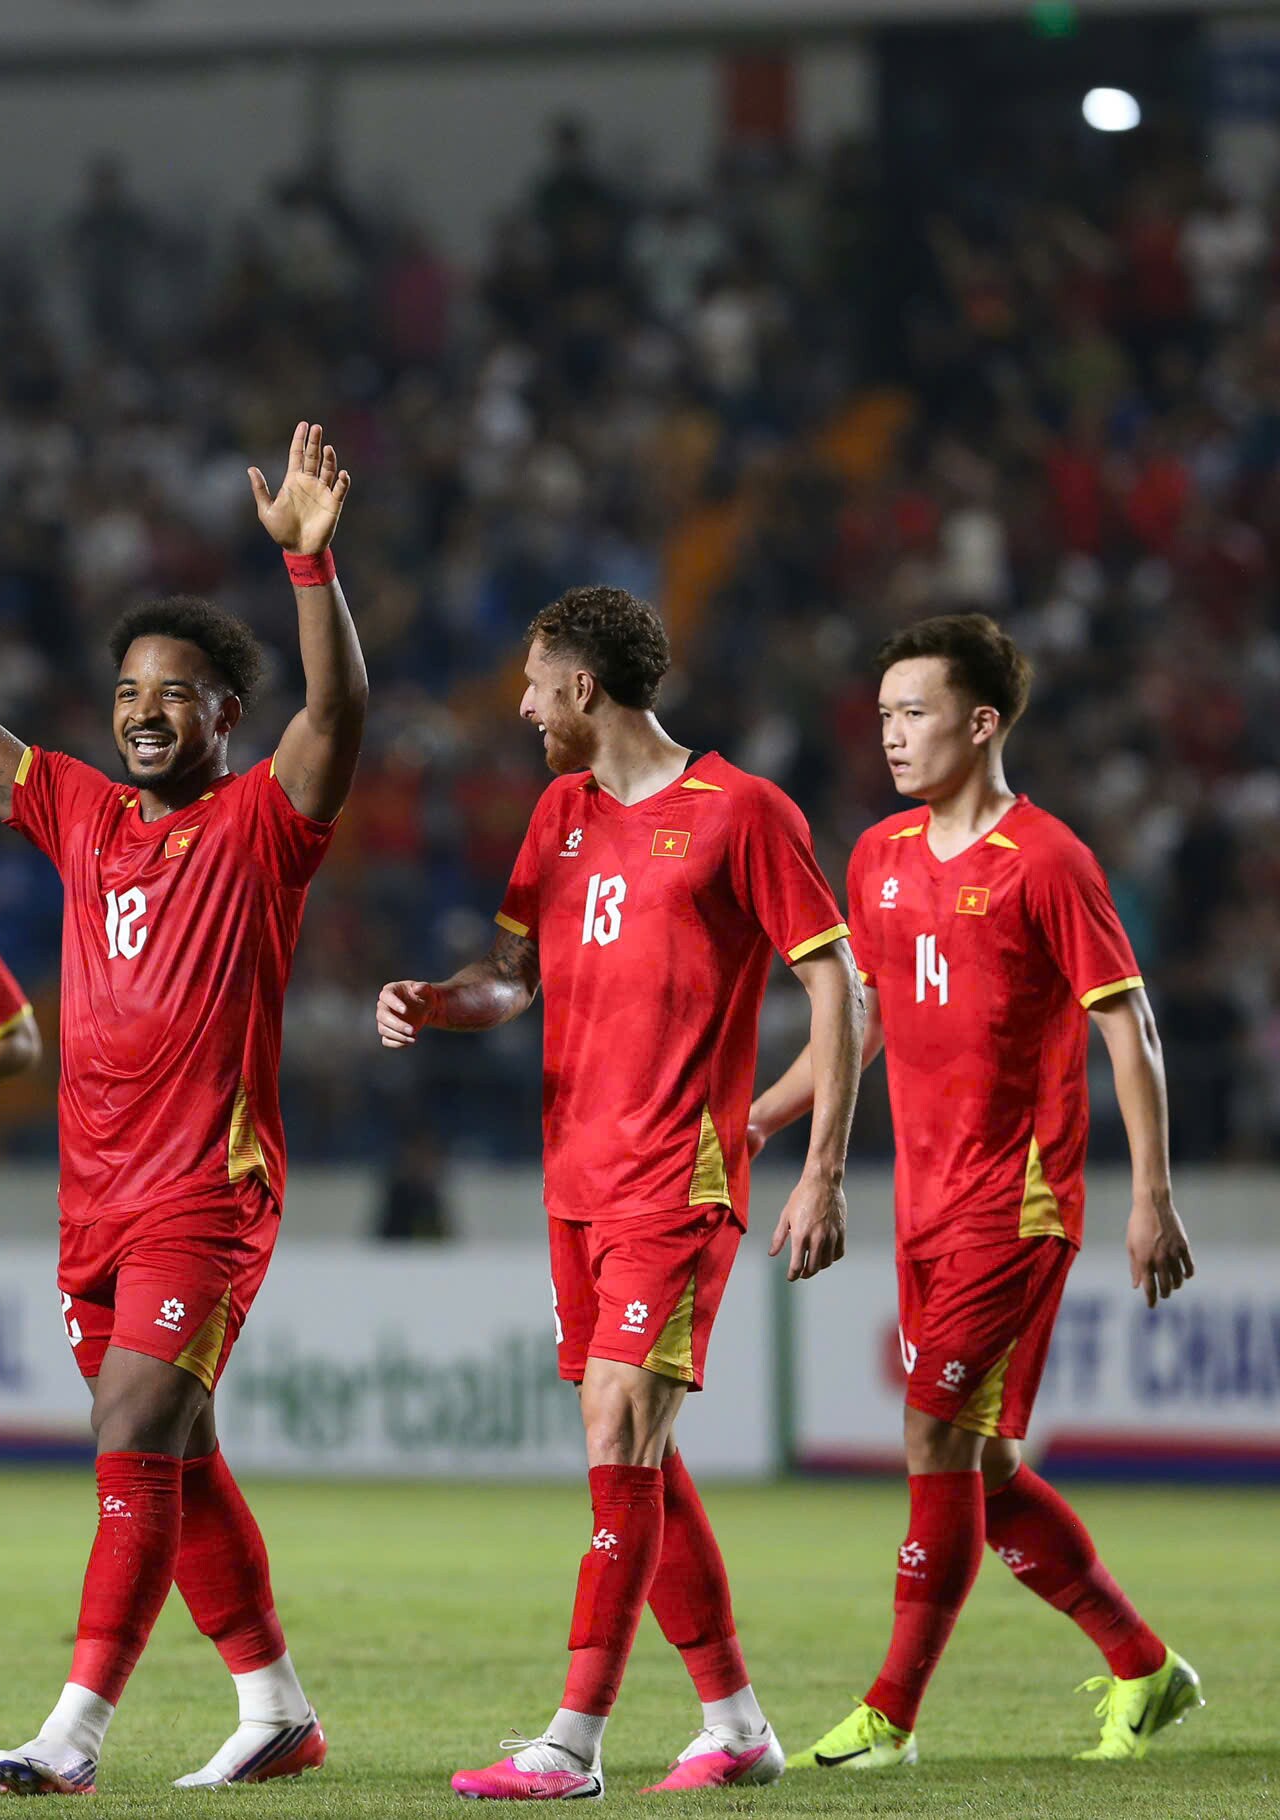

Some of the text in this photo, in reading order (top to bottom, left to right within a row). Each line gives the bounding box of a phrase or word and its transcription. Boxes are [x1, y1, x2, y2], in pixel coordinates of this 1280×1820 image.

[105, 886, 148, 960] 12
[581, 873, 628, 947] 13
[915, 933, 949, 1006] 14
